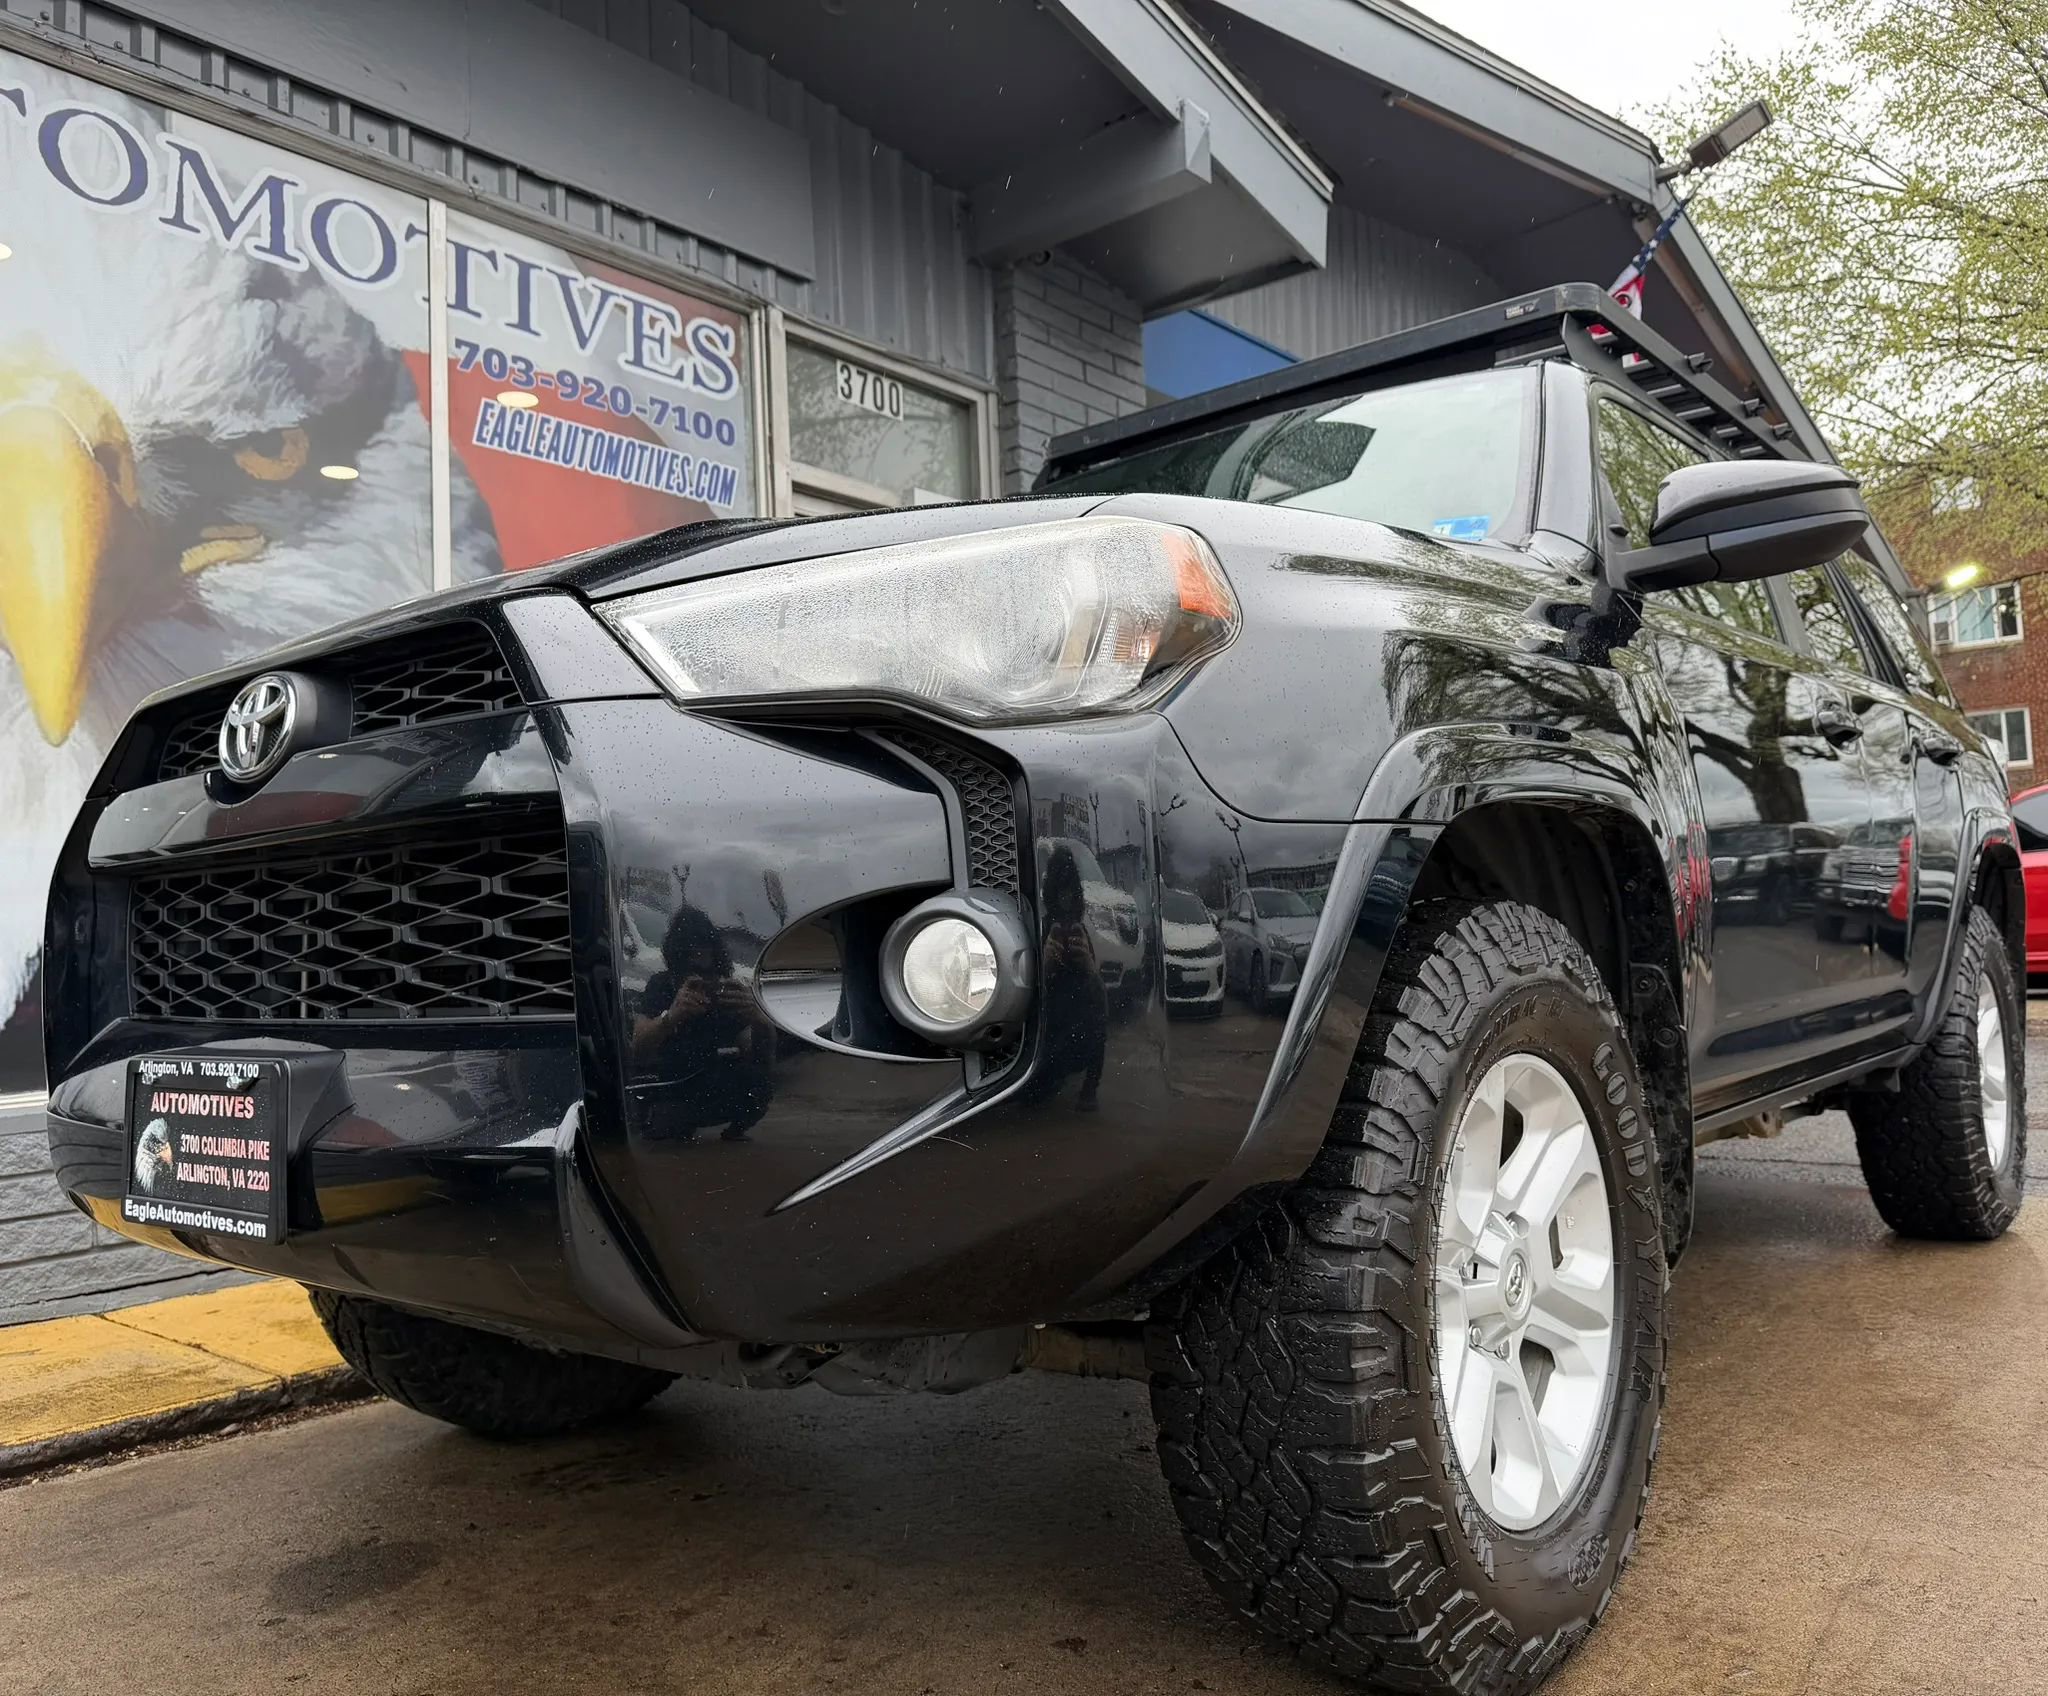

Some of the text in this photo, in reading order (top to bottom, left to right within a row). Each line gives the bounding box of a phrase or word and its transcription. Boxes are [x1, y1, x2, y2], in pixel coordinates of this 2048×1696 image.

[454, 338, 736, 447] 703-920-7100
[840, 364, 901, 418] 3700
[475, 401, 737, 507] EAGLEAUTOMOTIVES.COM
[139, 1060, 259, 1078] Arlington, VA 703.920.7100
[150, 1091, 255, 1119] AUTOMOTIVES
[180, 1133, 270, 1160] 3700 COLUMBIA PIKE
[176, 1162, 231, 1191] ARLINGTON,
[232, 1167, 246, 1188] VA
[125, 1199, 267, 1238] EagleAutomotives.com
